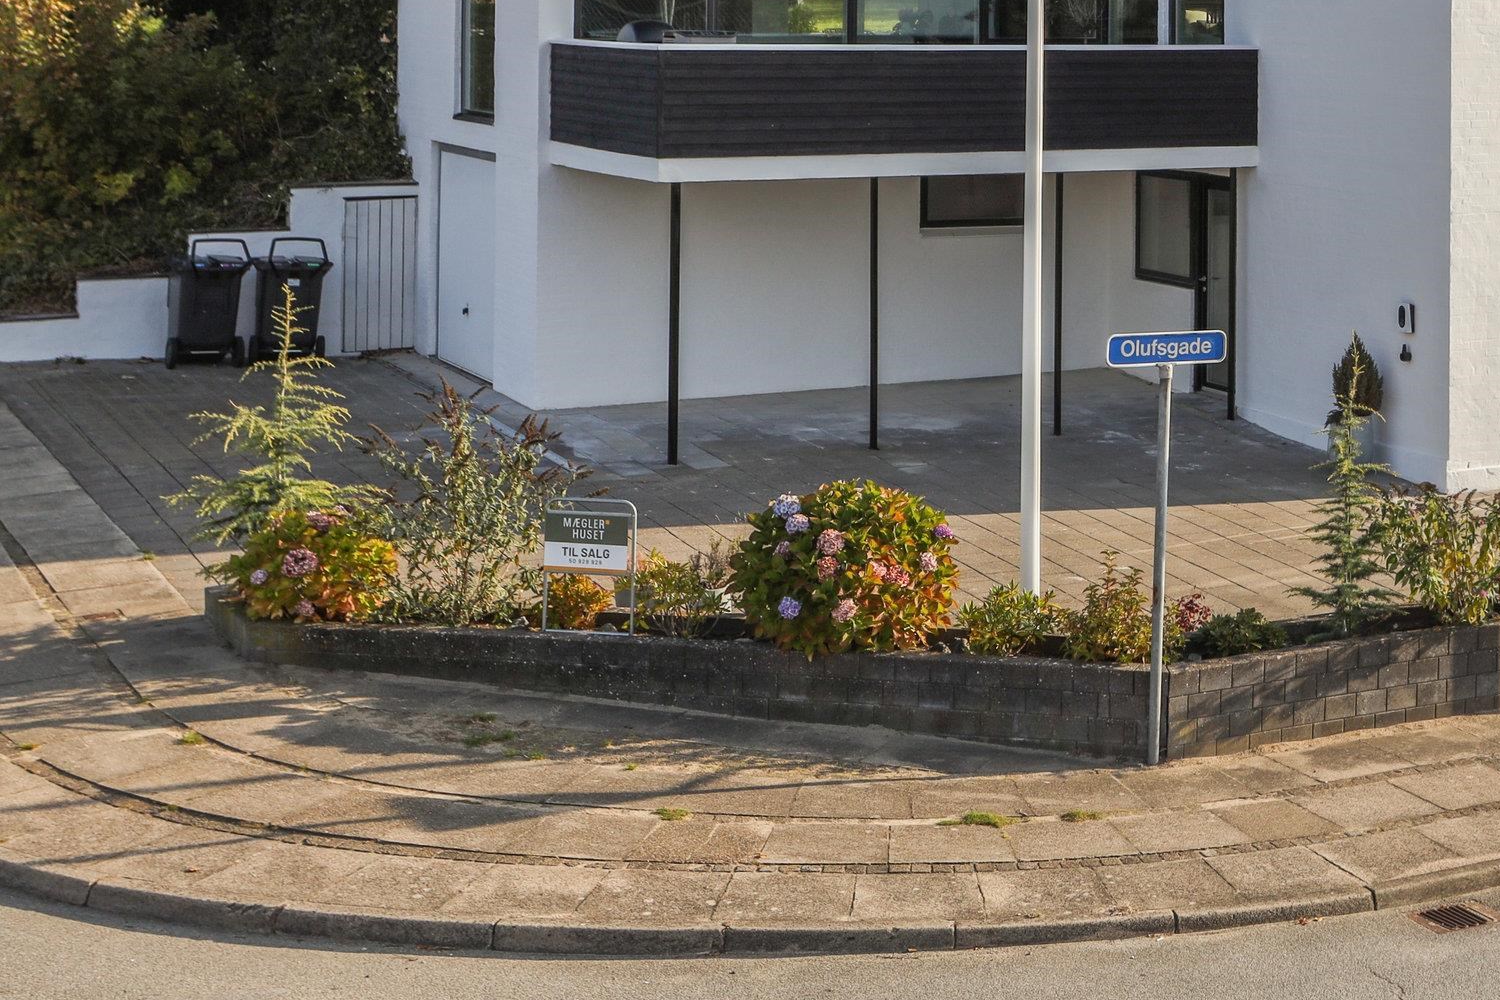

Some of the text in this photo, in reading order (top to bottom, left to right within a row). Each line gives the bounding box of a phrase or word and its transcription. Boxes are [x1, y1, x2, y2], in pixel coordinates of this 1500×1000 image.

[1120, 338, 1212, 358] Olufsgade
[563, 517, 605, 530] MÆGLER
[572, 529, 605, 540] HUSET
[562, 546, 610, 559] TIL SALG
